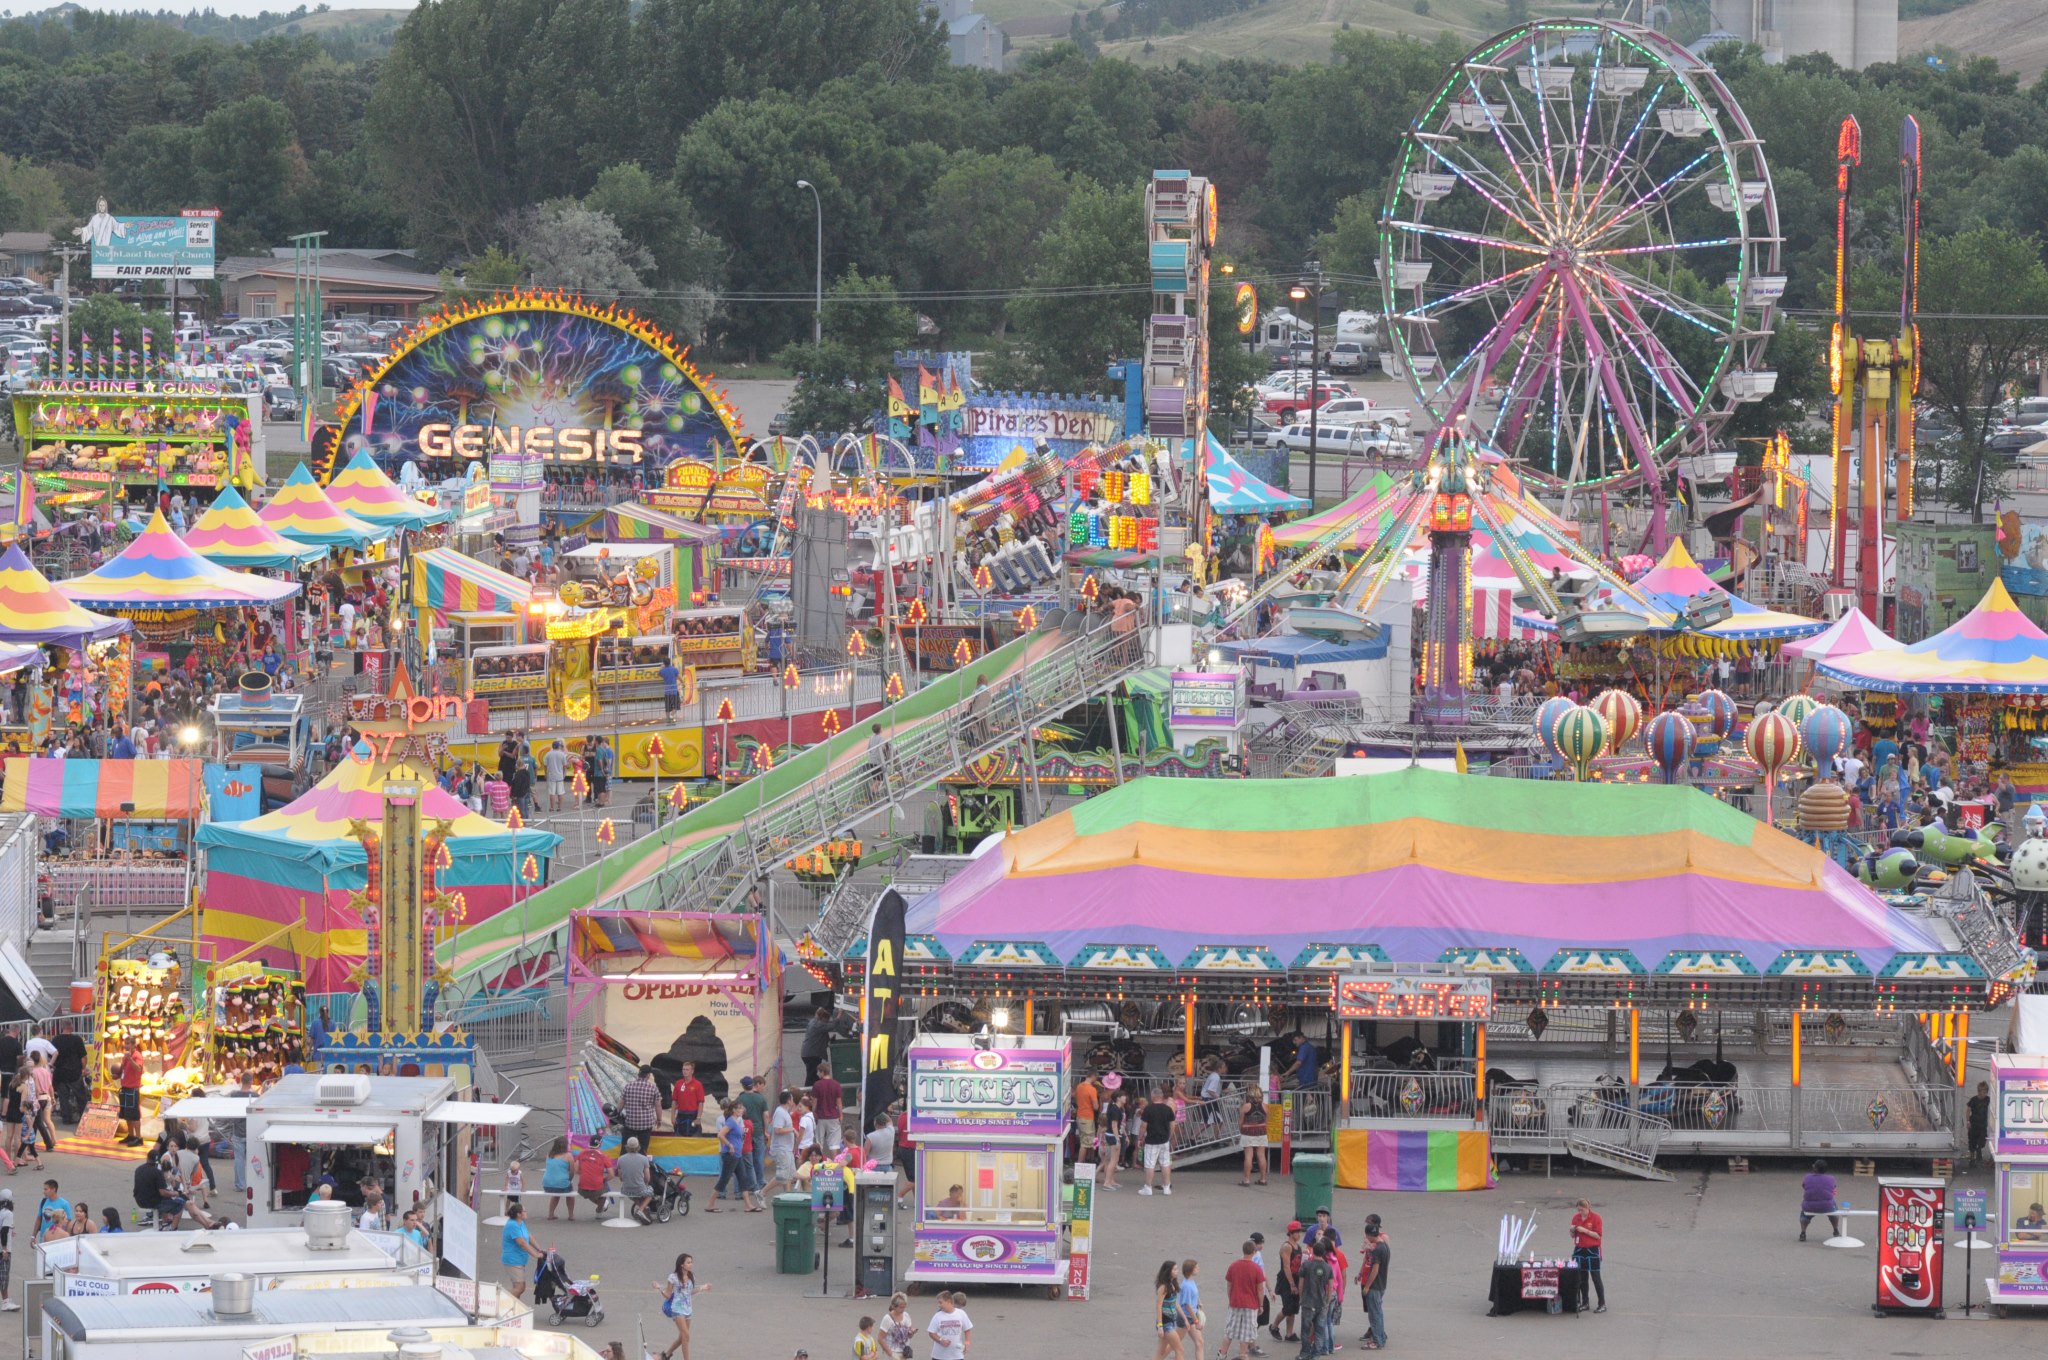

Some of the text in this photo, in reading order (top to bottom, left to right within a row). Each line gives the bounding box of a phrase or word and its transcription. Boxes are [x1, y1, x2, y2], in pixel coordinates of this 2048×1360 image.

[189, 221, 209, 229] Service
[136, 232, 153, 243] Alive
[153, 230, 166, 240] and
[181, 250, 212, 260] Church
[116, 266, 192, 276] FAIR PARKNG
[39, 380, 218, 395] MACHINE GUNS
[1051, 410, 1094, 436] Den
[418, 422, 645, 465] GENESIS
[676, 463, 712, 479] FUNNEL
[678, 476, 708, 487] CAKES
[1079, 468, 1151, 506] FUN
[1069, 512, 1160, 552] SLIDE
[922, 628, 974, 640] ANGEL
[708, 636, 740, 649] Rock
[596, 668, 660, 683] Hard Roc
[473, 676, 546, 692] Hard Rock
[1173, 689, 1234, 706] TICKETS
[350, 729, 456, 767] STAR
[622, 983, 704, 1001] SPEED
[205, 986, 213, 1018] ONE
[710, 1001, 729, 1009] How
[868, 938, 896, 1074] ATM
[92, 975, 106, 1082] ONE IN WINS
[204, 1022, 211, 1044] IN
[918, 1075, 1056, 1107] TICKETS
[954, 1118, 987, 1126] MAKERS
[875, 1194, 890, 1202] ATM
[75, 1279, 110, 1290] ICE COLD
[1073, 1268, 1083, 1285] NO
